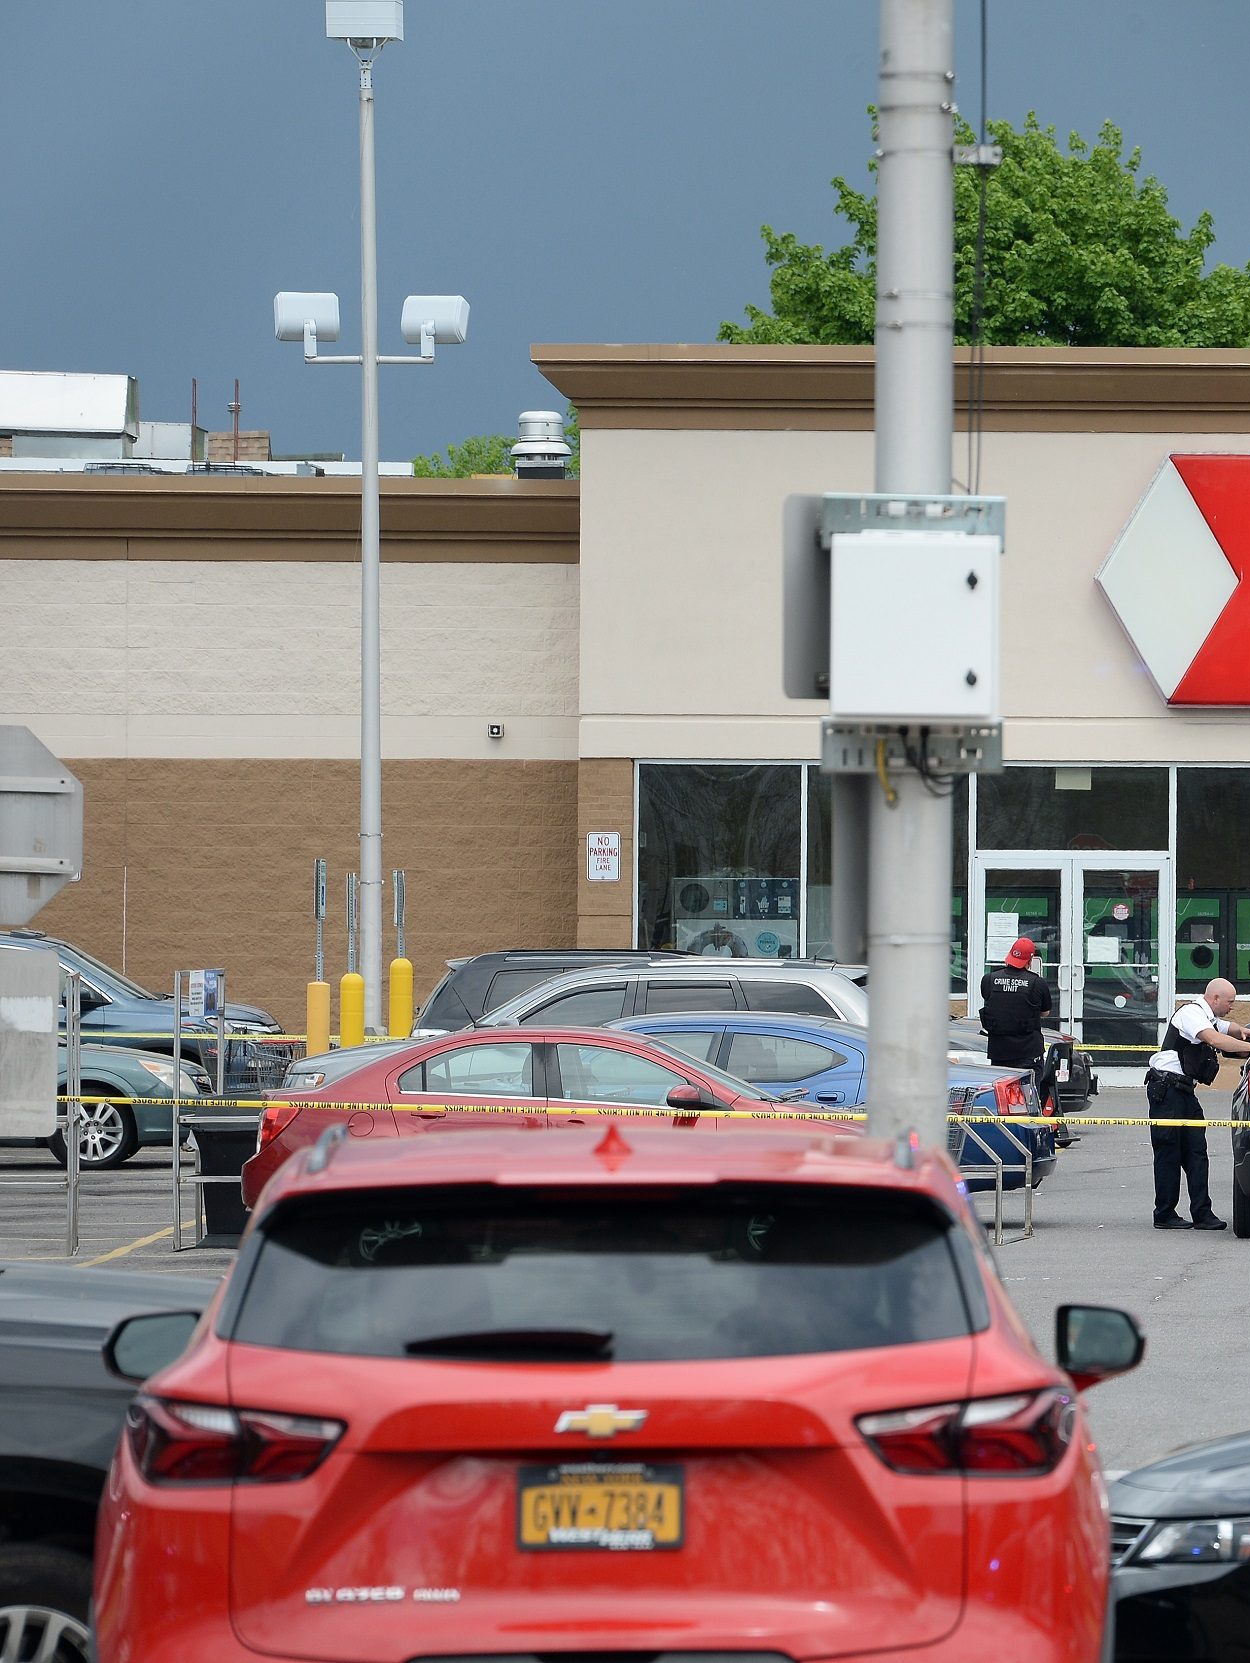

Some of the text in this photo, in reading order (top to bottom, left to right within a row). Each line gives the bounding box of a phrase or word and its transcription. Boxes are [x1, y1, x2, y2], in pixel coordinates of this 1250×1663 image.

[597, 836, 610, 846] NO
[589, 848, 618, 857] PARKING
[994, 978, 1029, 987] CRIME SCENE
[1003, 985, 1019, 993] UNIT
